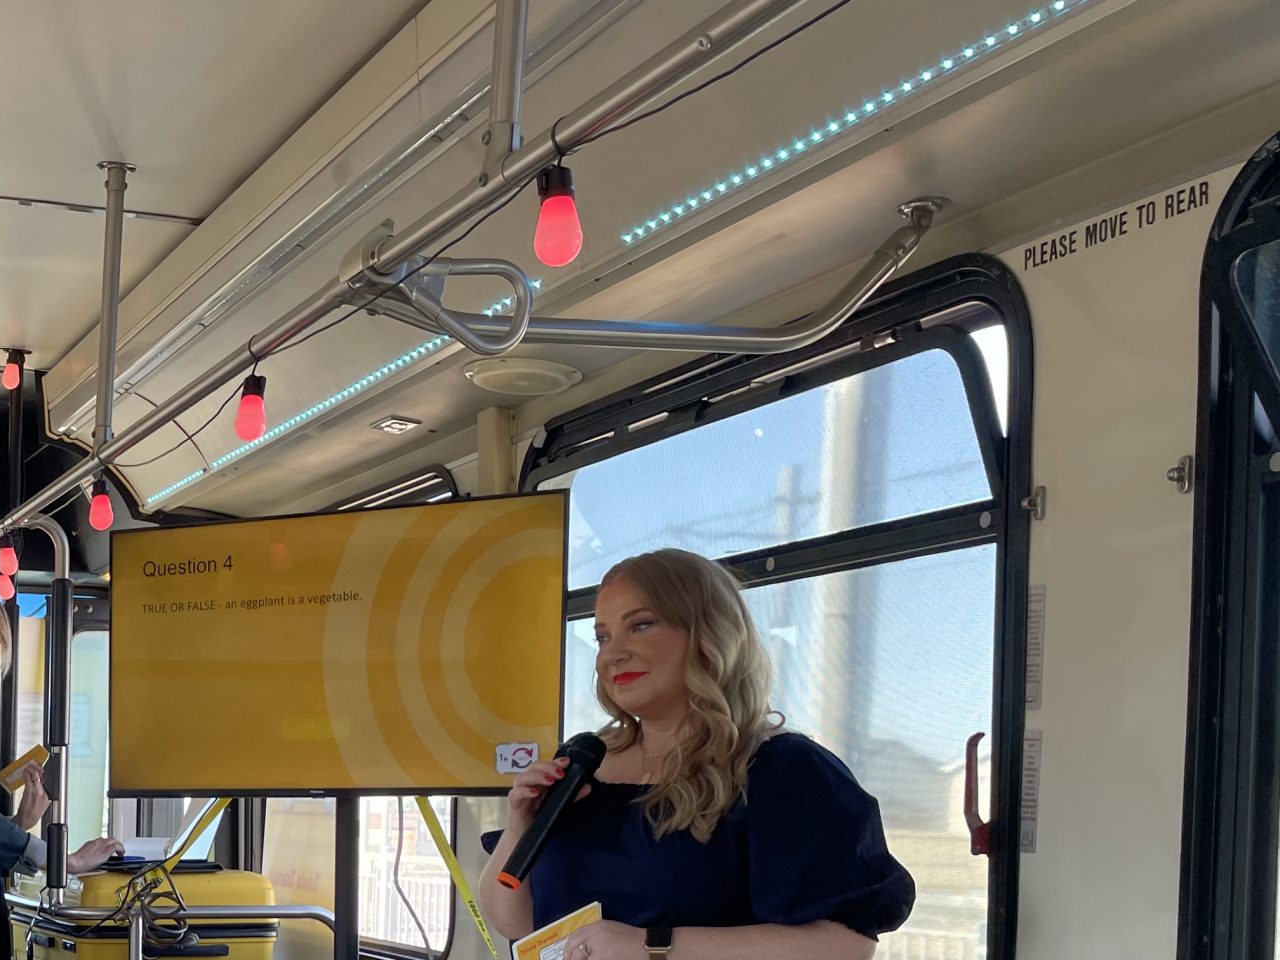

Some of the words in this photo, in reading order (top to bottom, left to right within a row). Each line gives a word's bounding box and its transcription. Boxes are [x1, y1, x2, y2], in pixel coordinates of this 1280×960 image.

[1024, 231, 1077, 271] PLEASE
[1084, 212, 1128, 248] MOVE
[1136, 201, 1156, 229] TO
[1164, 181, 1209, 219] REAR
[143, 557, 217, 577] Question
[223, 554, 233, 571] 4
[143, 603, 168, 614] TRUE
[170, 602, 185, 613] OR
[187, 600, 216, 611] FALSE
[225, 600, 237, 609] an
[240, 596, 284, 609] eggplant
[287, 595, 295, 605] is
[298, 596, 305, 605] a
[307, 590, 362, 605] vegetable.
